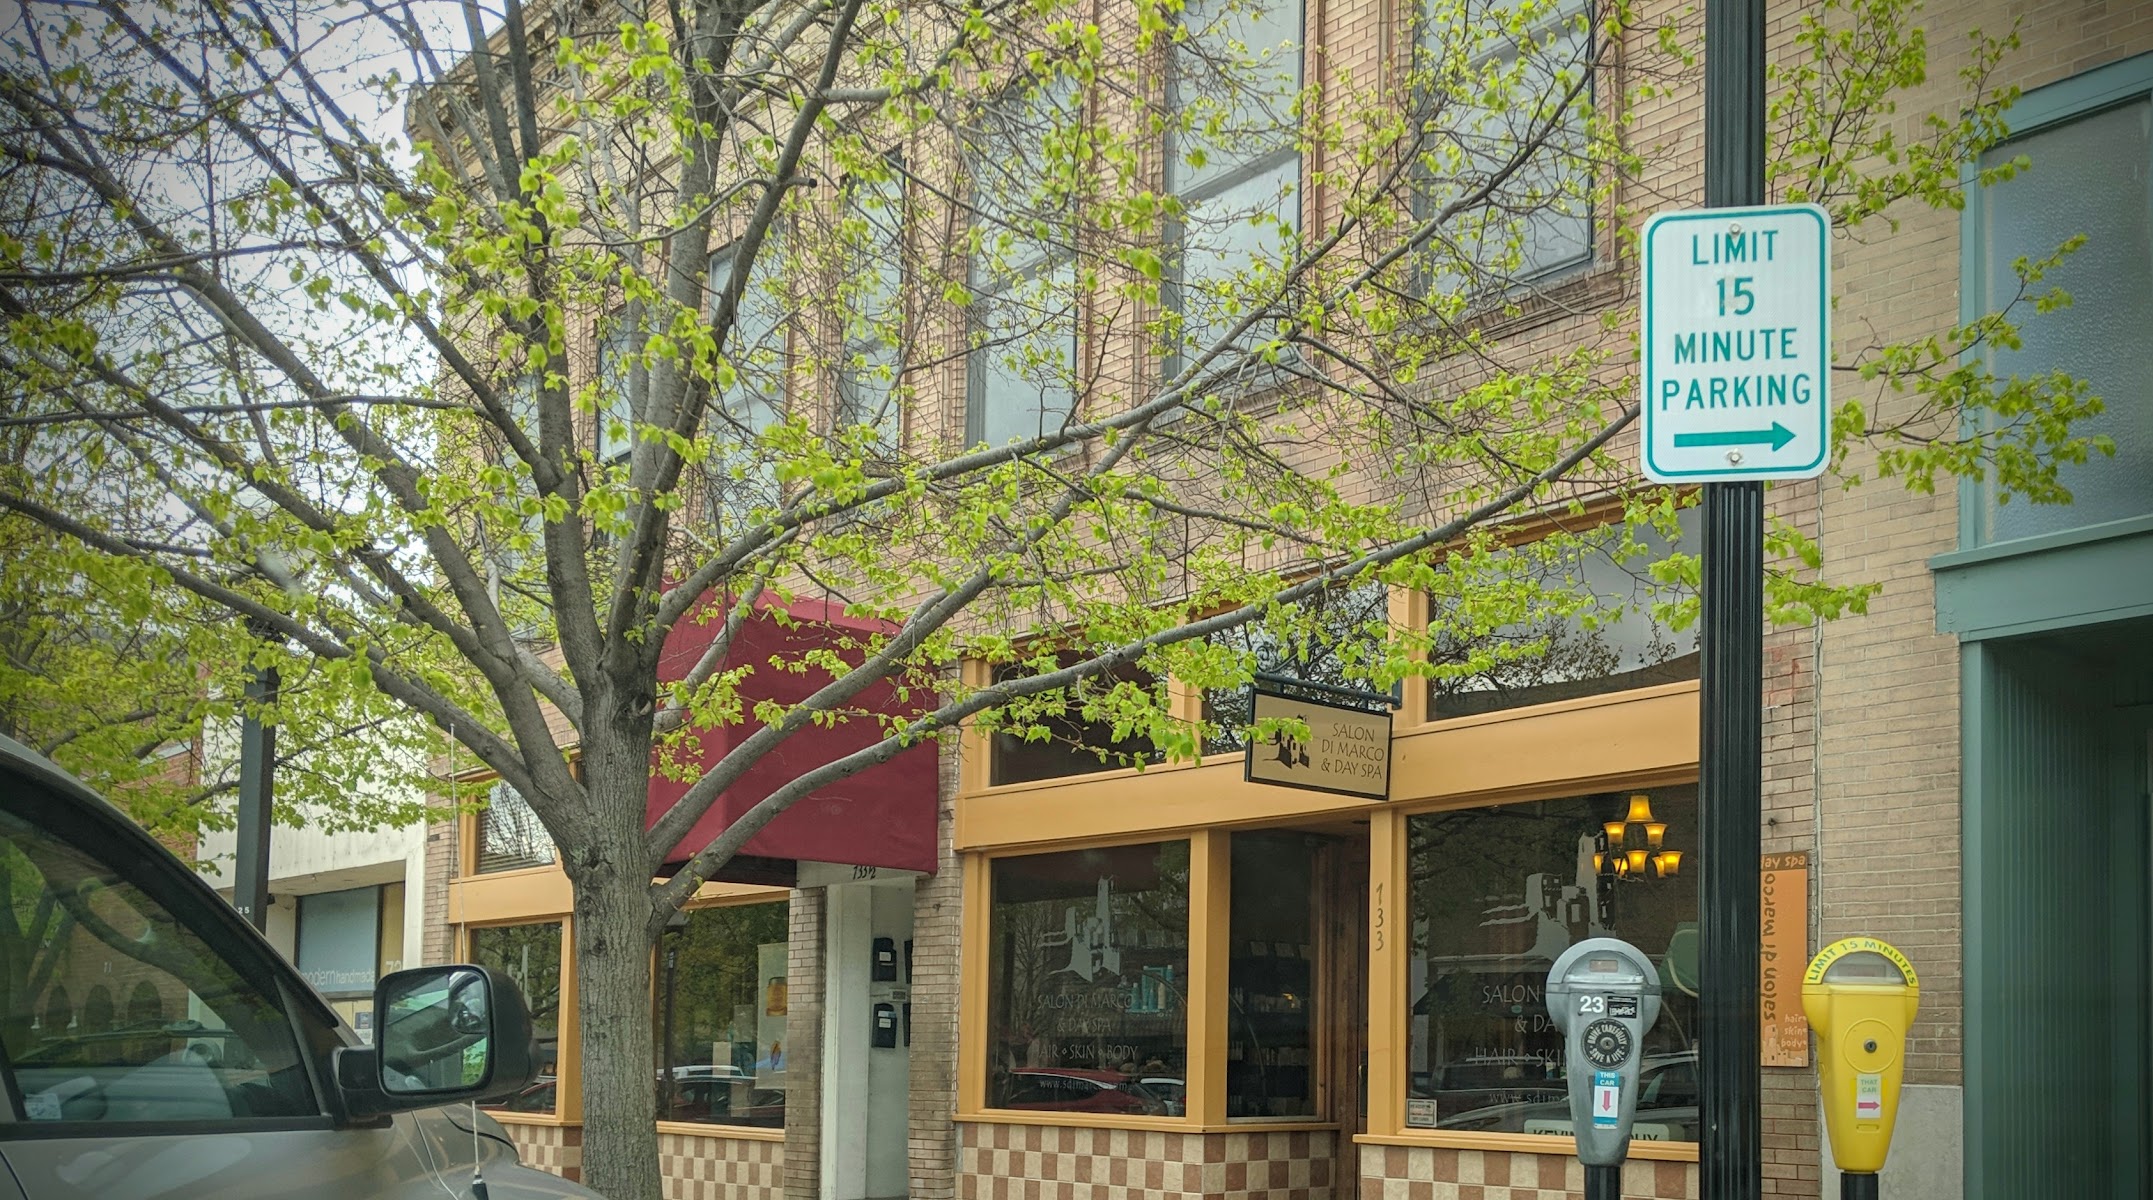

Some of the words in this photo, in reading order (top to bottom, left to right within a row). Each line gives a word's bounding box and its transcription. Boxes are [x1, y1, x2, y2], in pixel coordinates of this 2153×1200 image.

[1692, 230, 1779, 265] LIMIT
[1717, 277, 1755, 317] 15
[1674, 328, 1798, 364] MINUTE
[1662, 374, 1811, 411] PARKING
[1332, 722, 1375, 742] SALON
[1321, 739, 1334, 755] DI
[1337, 743, 1385, 762] MARCO
[1321, 758, 1331, 773] &
[1334, 760, 1359, 775] DAY
[1361, 763, 1383, 779] SPA
[1784, 855, 1806, 869] spa
[1763, 873, 1776, 937] marco
[1375, 882, 1385, 951] 133
[1808, 948, 1837, 981] LIMIT
[1841, 941, 1858, 951] 15
[1864, 940, 1916, 985] MINUTES
[1037, 993, 1074, 1010] SALON
[1482, 984, 1540, 1004] SALON
[1761, 967, 1777, 1020] salon
[1579, 995, 1605, 1013] 23
[1514, 1014, 1528, 1034] &
[1533, 1014, 1558, 1033] DA
[1784, 1013, 1802, 1023] hair
[1587, 1026, 1602, 1044] DRIVE
[1601, 1024, 1628, 1045] CAREFULLY
[1784, 1026, 1803, 1036] skin
[1069, 1044, 1095, 1060] SKIN
[1106, 1045, 1139, 1060] BODY
[1781, 1038, 1803, 1048] body
[1475, 1046, 1519, 1066] HAIR
[1589, 1048, 1605, 1063] SAVE
[1611, 1048, 1625, 1062] LIFE
